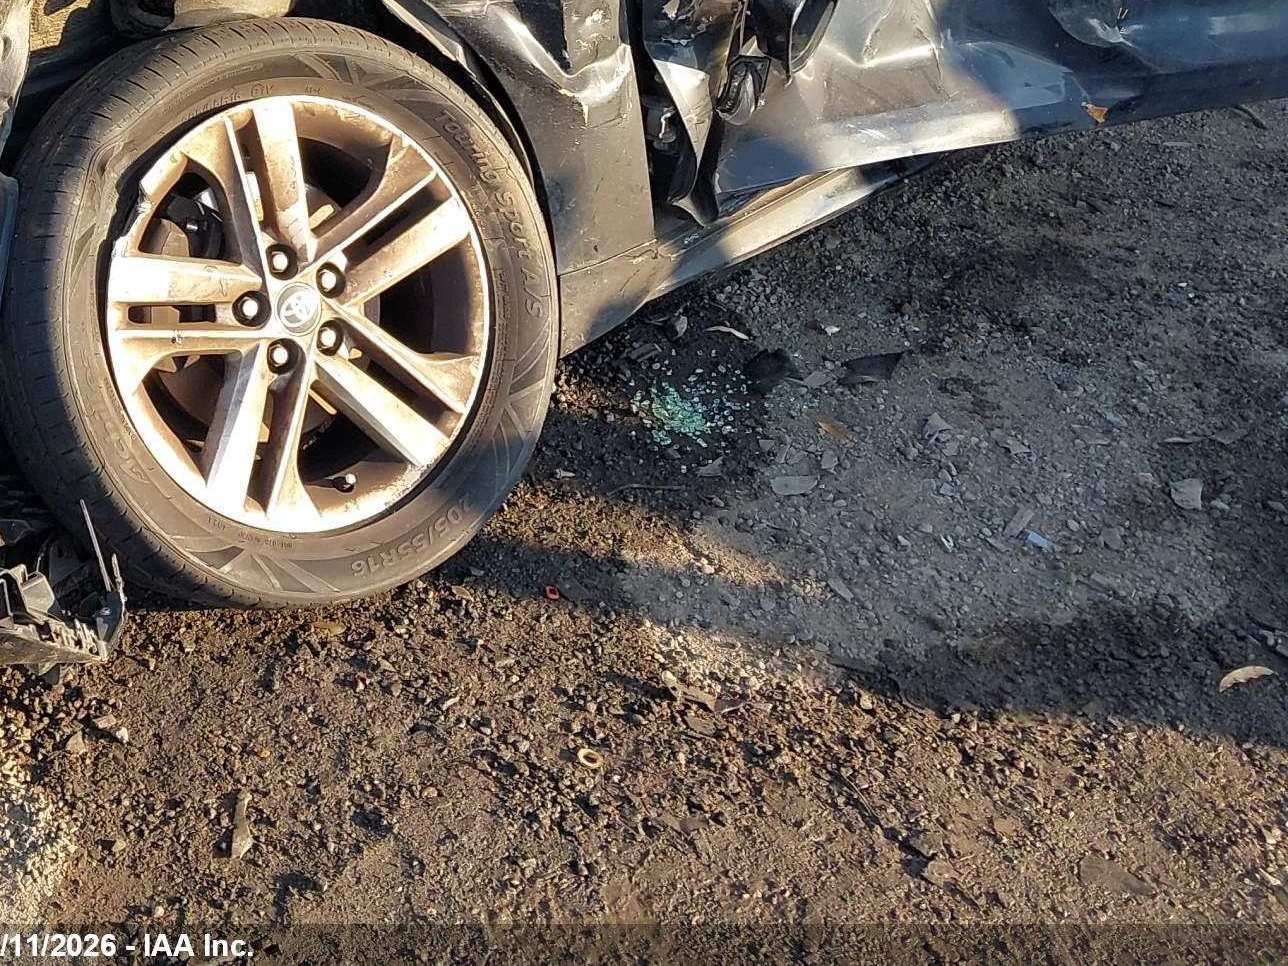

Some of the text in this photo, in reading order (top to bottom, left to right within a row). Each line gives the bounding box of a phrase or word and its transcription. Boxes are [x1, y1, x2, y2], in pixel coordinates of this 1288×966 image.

[433, 109, 502, 184] Touring
[493, 190, 532, 261] Sport
[519, 265, 543, 319] A/S
[349, 494, 475, 579] 205/55R16
